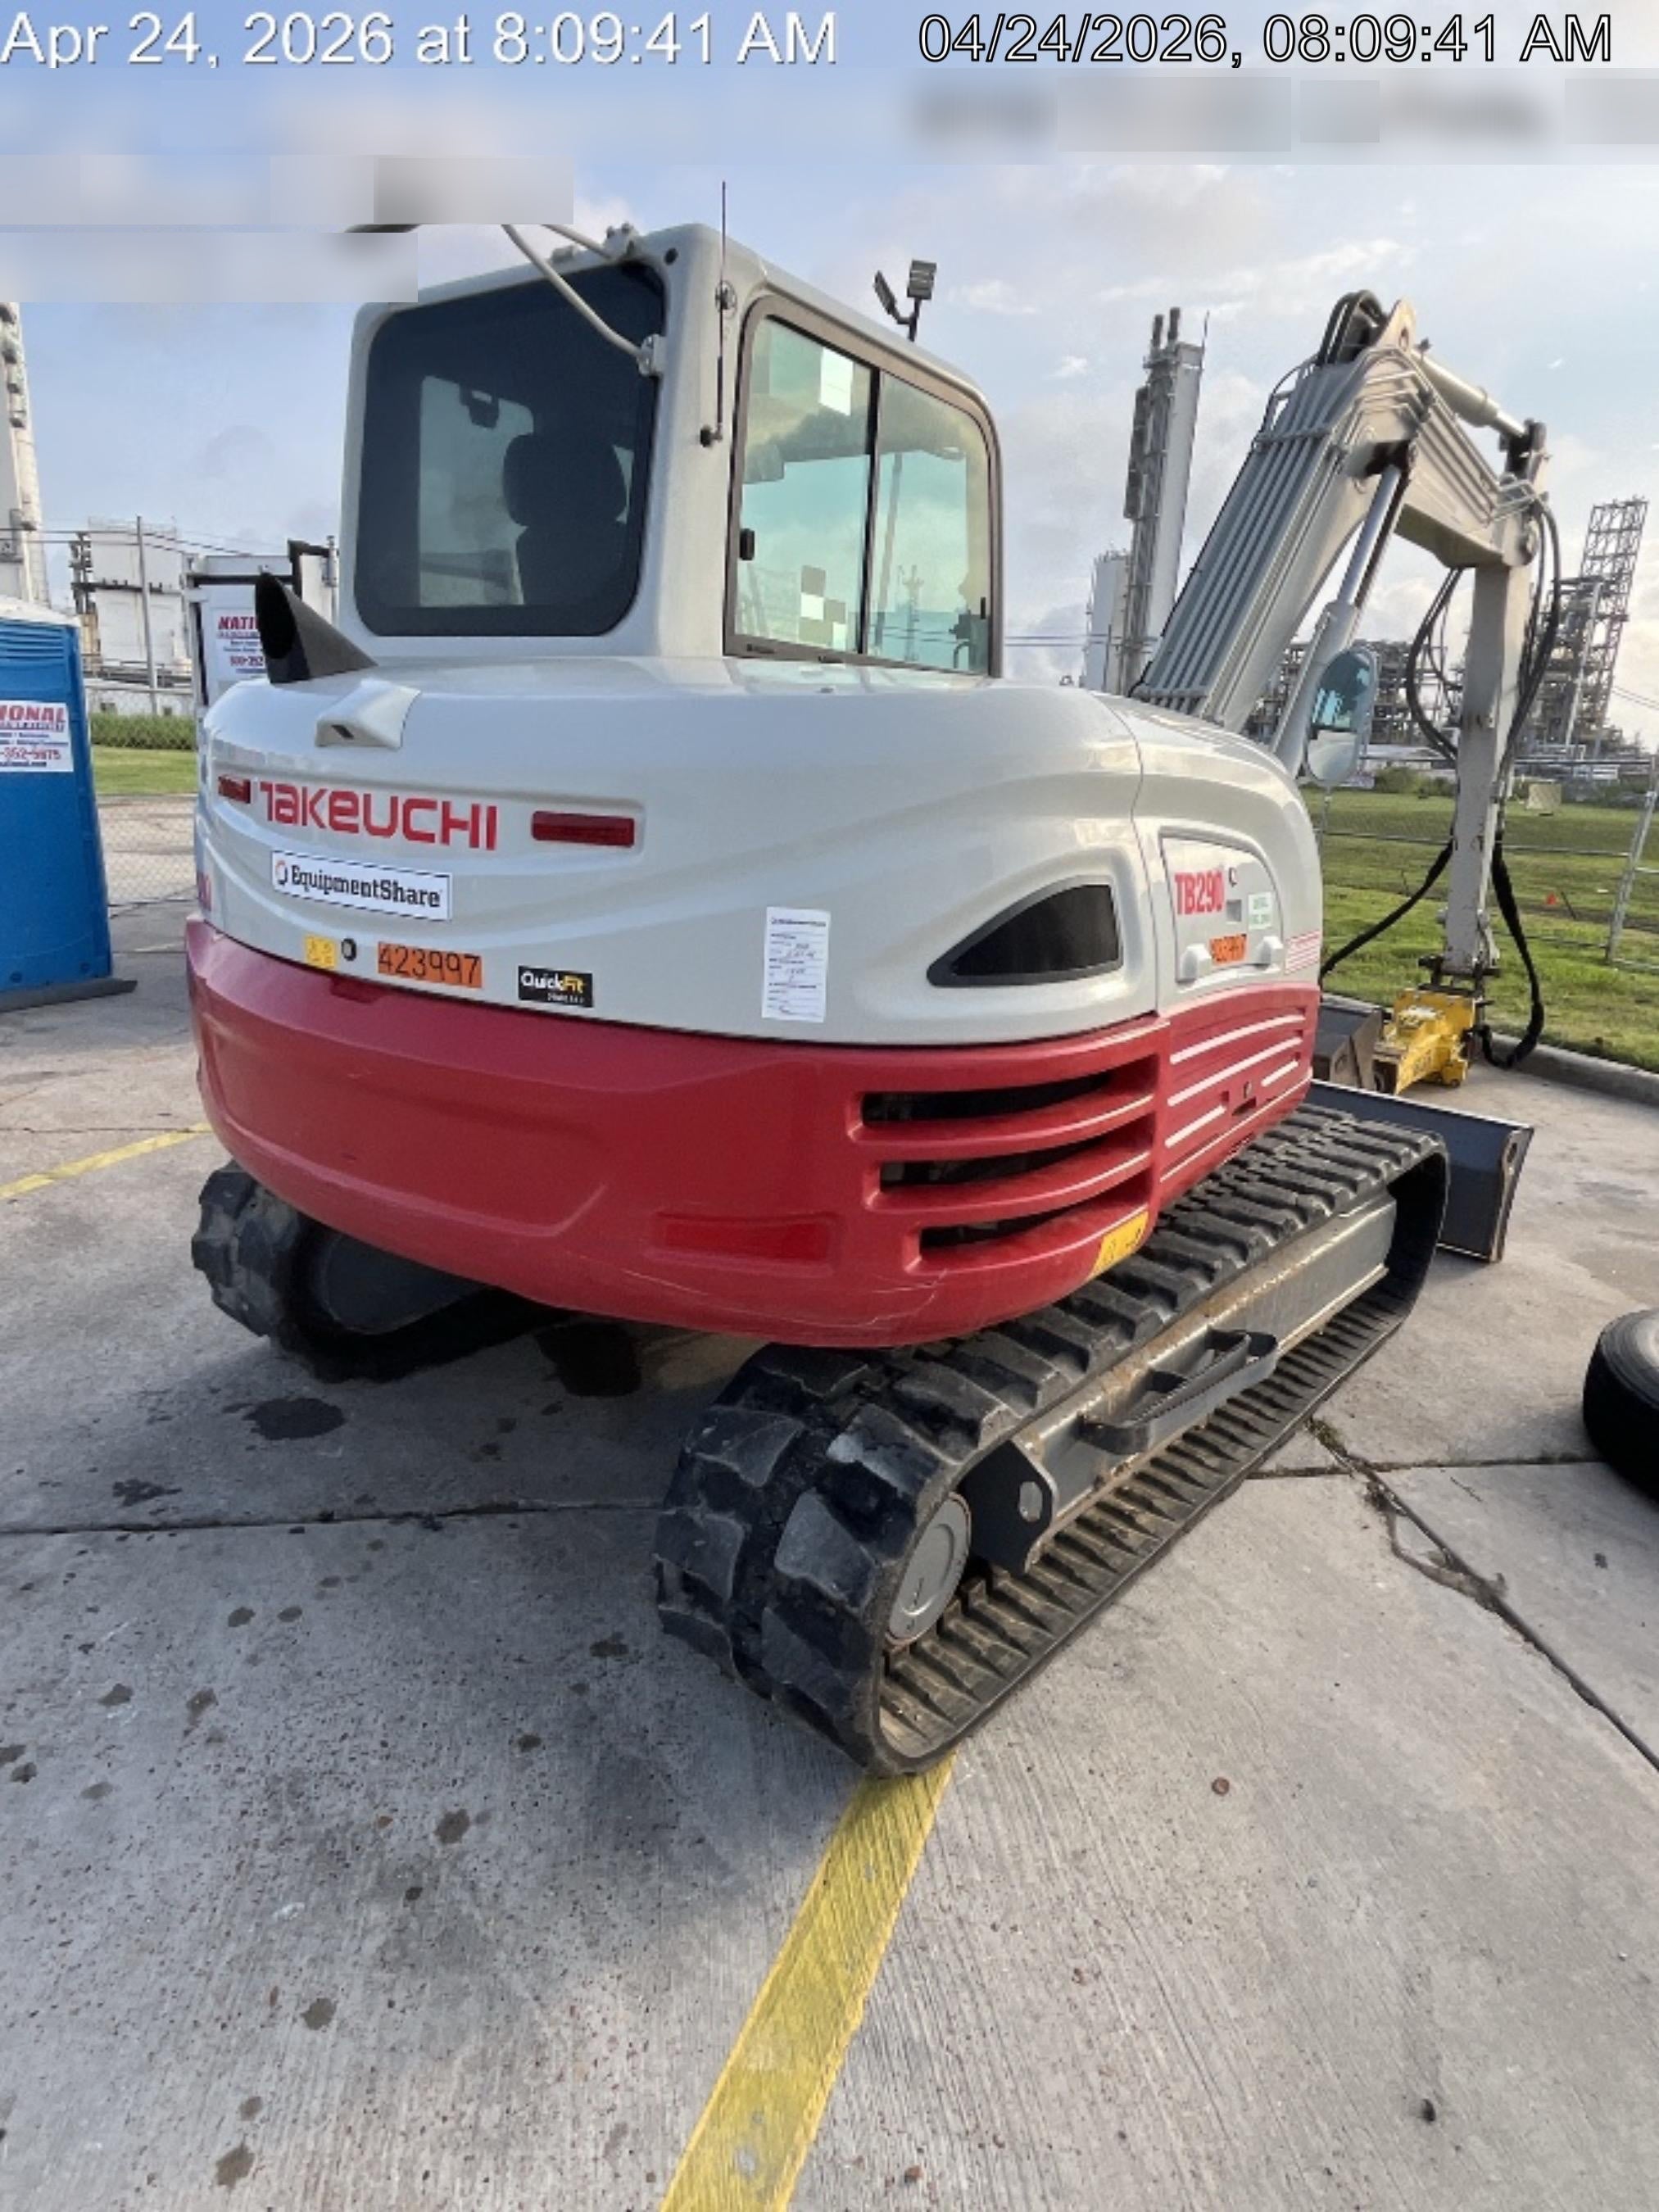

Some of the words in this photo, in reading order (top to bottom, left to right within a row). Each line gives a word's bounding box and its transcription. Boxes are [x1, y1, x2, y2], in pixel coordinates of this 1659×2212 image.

[218, 616, 260, 630] NATI
[291, 864, 441, 908] EquipmentShare
[1174, 869, 1224, 915] TB290
[378, 942, 481, 985] 423997
